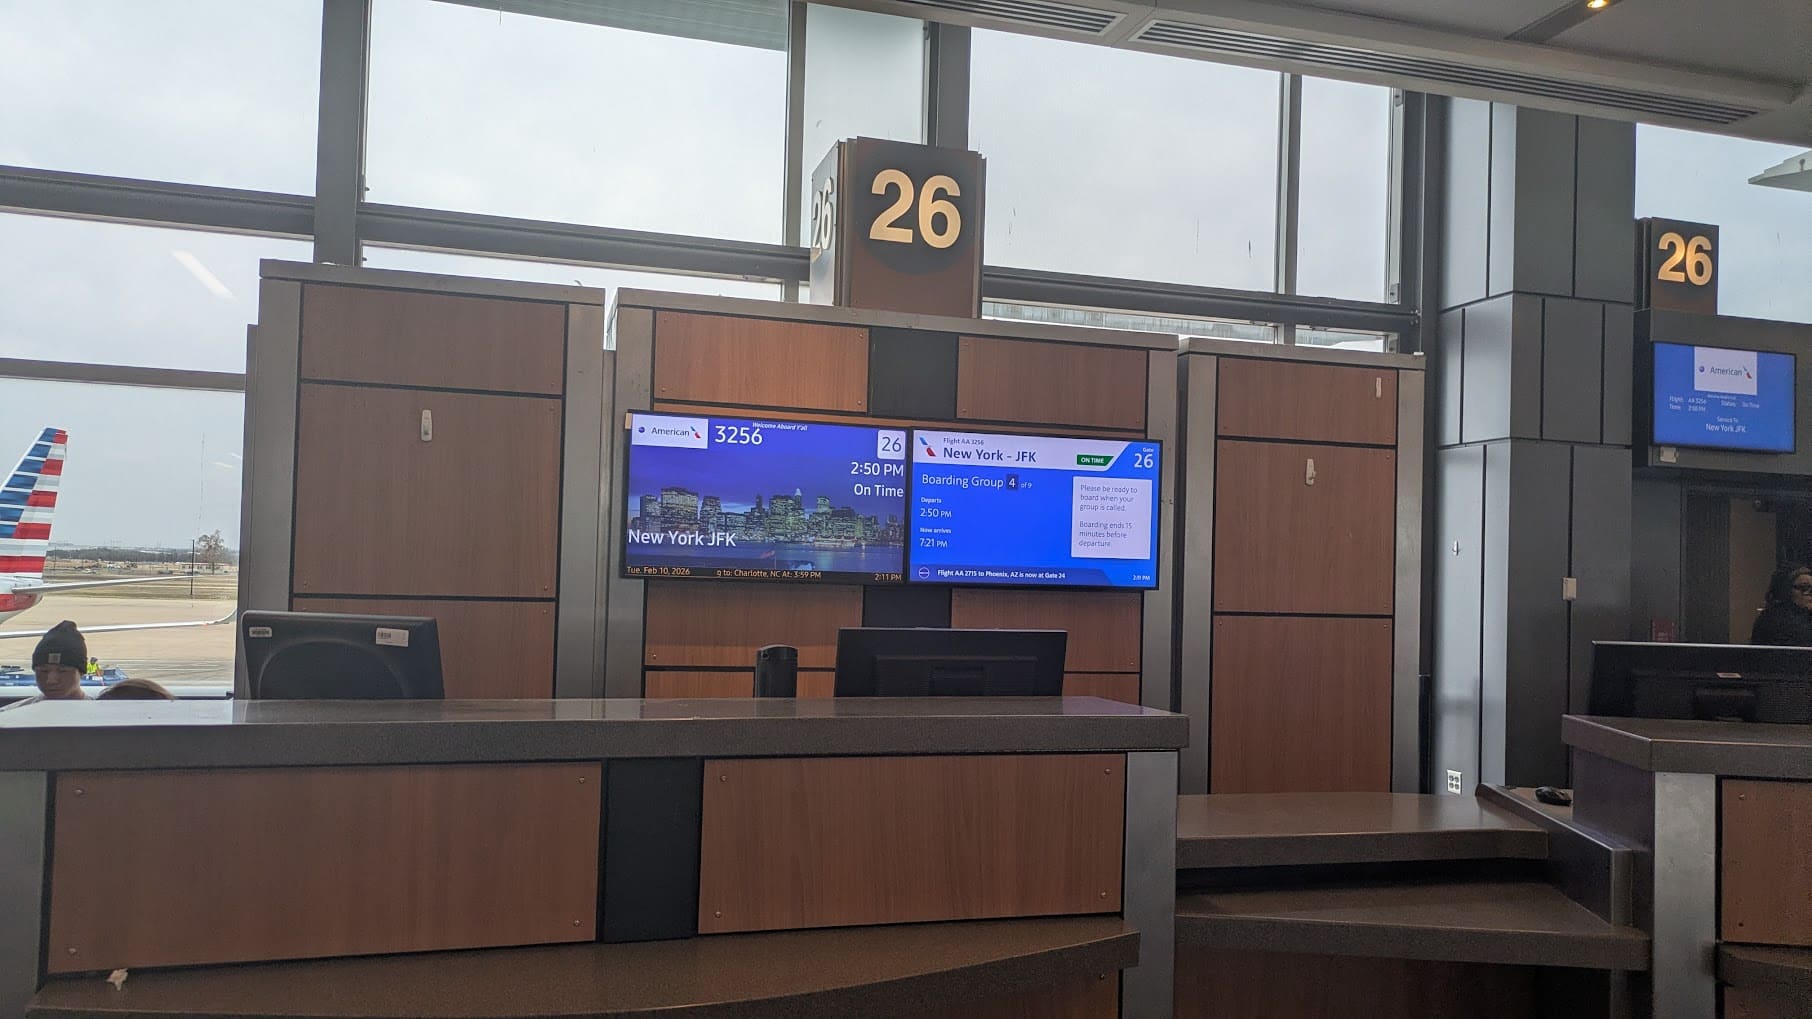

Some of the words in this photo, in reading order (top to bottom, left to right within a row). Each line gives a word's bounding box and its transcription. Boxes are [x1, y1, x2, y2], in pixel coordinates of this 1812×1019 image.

[870, 169, 961, 248] 26
[812, 177, 833, 262] 26
[1658, 232, 1713, 286] 26
[1710, 365, 1743, 376] American
[752, 421, 776, 429] Welcome
[1705, 423, 1719, 432] New
[1721, 424, 1734, 433] York
[1735, 425, 1746, 433] JFK
[651, 427, 690, 438] American
[714, 425, 763, 445] 3256
[881, 436, 902, 452] 26
[943, 437, 960, 445] Flight
[943, 447, 972, 459] New
[976, 448, 1004, 461] York
[1015, 451, 1037, 462] JFK
[1133, 453, 1154, 469] 26
[851, 461, 880, 476] 2:50
[884, 463, 904, 477] PM
[922, 474, 969, 489] Boarding
[971, 476, 1004, 490] Group
[1008, 478, 1016, 487] 4
[854, 483, 871, 496] On
[874, 484, 904, 497] Time
[1080, 484, 1101, 492] Please
[1102, 485, 1110, 493] be
[1111, 486, 1130, 495] ready
[920, 496, 942, 505] Departs
[1100, 494, 1118, 502] when
[920, 508, 939, 517] 2:50
[940, 510, 952, 518] PM
[1079, 503, 1099, 512] group
[1079, 521, 1108, 530] Boarding
[628, 529, 663, 543] New
[668, 531, 704, 546] York
[707, 531, 736, 546] JFK
[1106, 531, 1127, 539] before
[920, 537, 935, 547] 7:21
[936, 540, 947, 548] PM
[671, 567, 690, 576] 2026
[810, 571, 821, 579] PM
[874, 573, 889, 581] 2:11
[890, 573, 902, 581] PM
[937, 569, 954, 577] Flight
[985, 570, 1010, 578] Phoenix,
